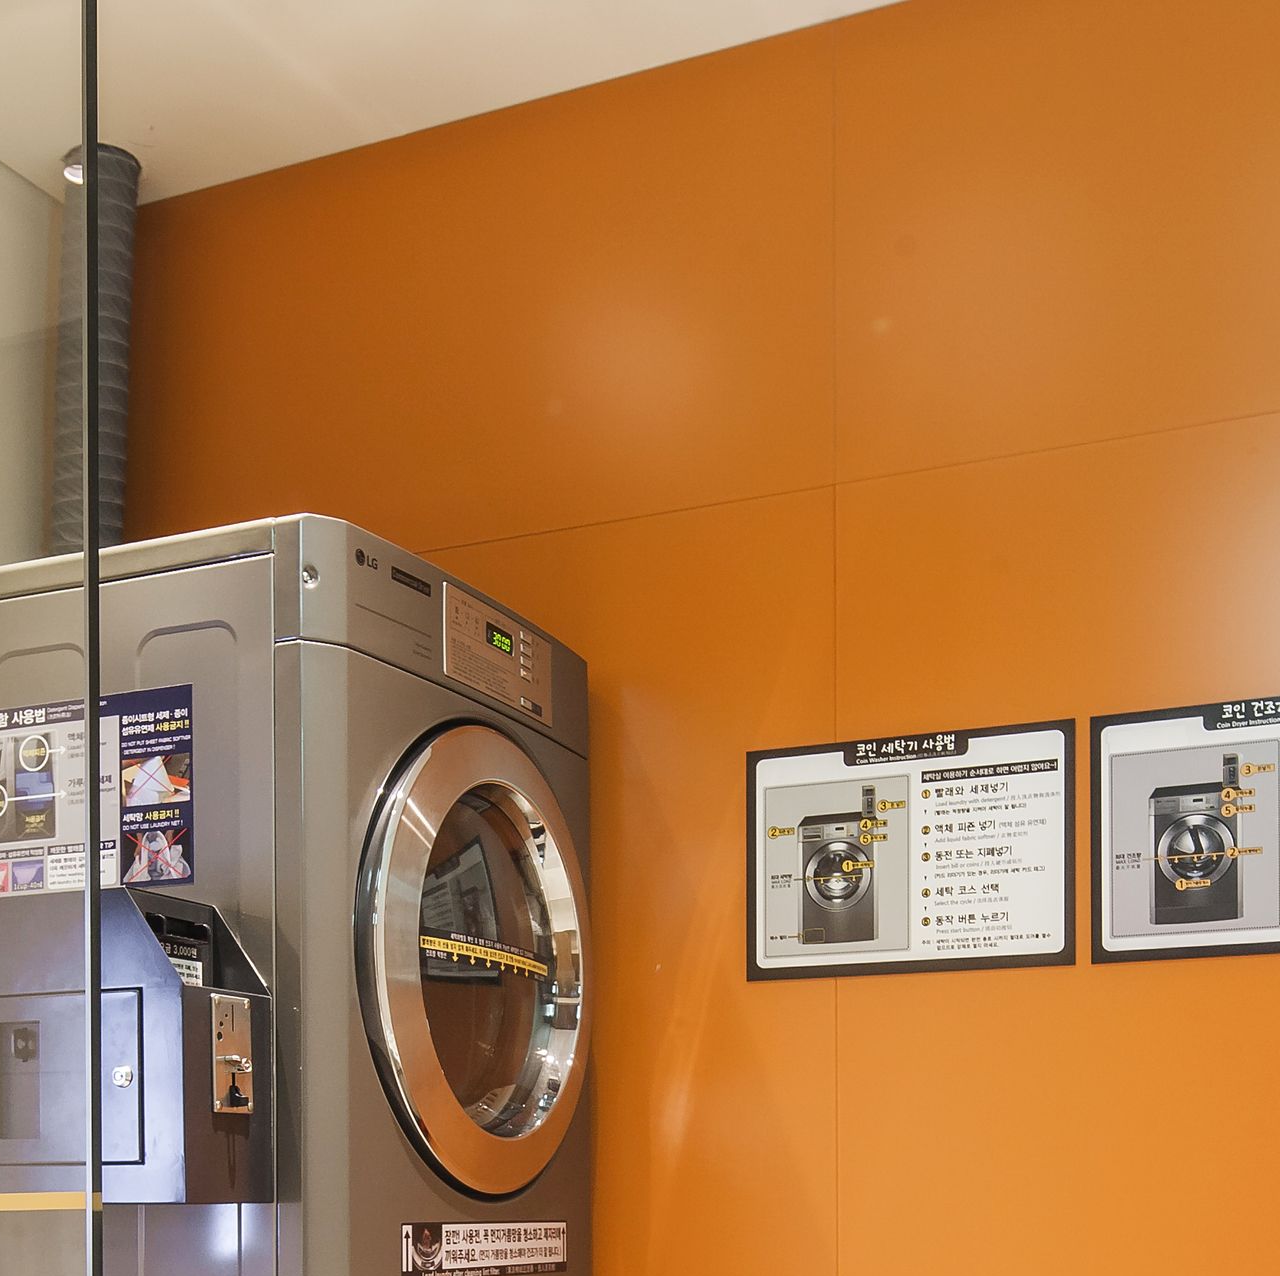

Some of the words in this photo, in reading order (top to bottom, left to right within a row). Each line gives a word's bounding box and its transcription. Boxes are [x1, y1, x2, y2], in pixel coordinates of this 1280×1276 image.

[367, 555, 378, 570] LG
[11, 708, 46, 725] 사용법
[1222, 702, 1246, 719] 코인
[155, 720, 183, 731] 사용금지
[1217, 721, 1231, 729] Coin
[1232, 720, 1248, 728] Dryer
[1249, 716, 1280, 726] Instruction
[856, 742, 876, 757] 코인
[881, 739, 918, 754] 세탁기
[923, 734, 955, 751] 사용법
[869, 756, 888, 764] Washer
[889, 753, 916, 762] Instruction
[996, 765, 1010, 775] 하면
[935, 786, 964, 798] 빨래와
[969, 781, 1009, 794] 세제넣기
[144, 809, 173, 820] 사용금지
[934, 824, 954, 834] 액체
[957, 821, 975, 832] 피존
[978, 819, 996, 830] 넣기
[104, 841, 114, 849] TIP
[935, 850, 953, 861] 동전
[956, 848, 974, 859] 또는
[977, 845, 1013, 857] 지폐넣기
[936, 886, 953, 897] 세탁
[958, 884, 976, 895] 코스
[981, 883, 1000, 894] 선택
[936, 915, 954, 926] 동작
[958, 913, 976, 925] 버튼
[980, 911, 1009, 922] 누르기
[173, 944, 197, 959] 3,000원
